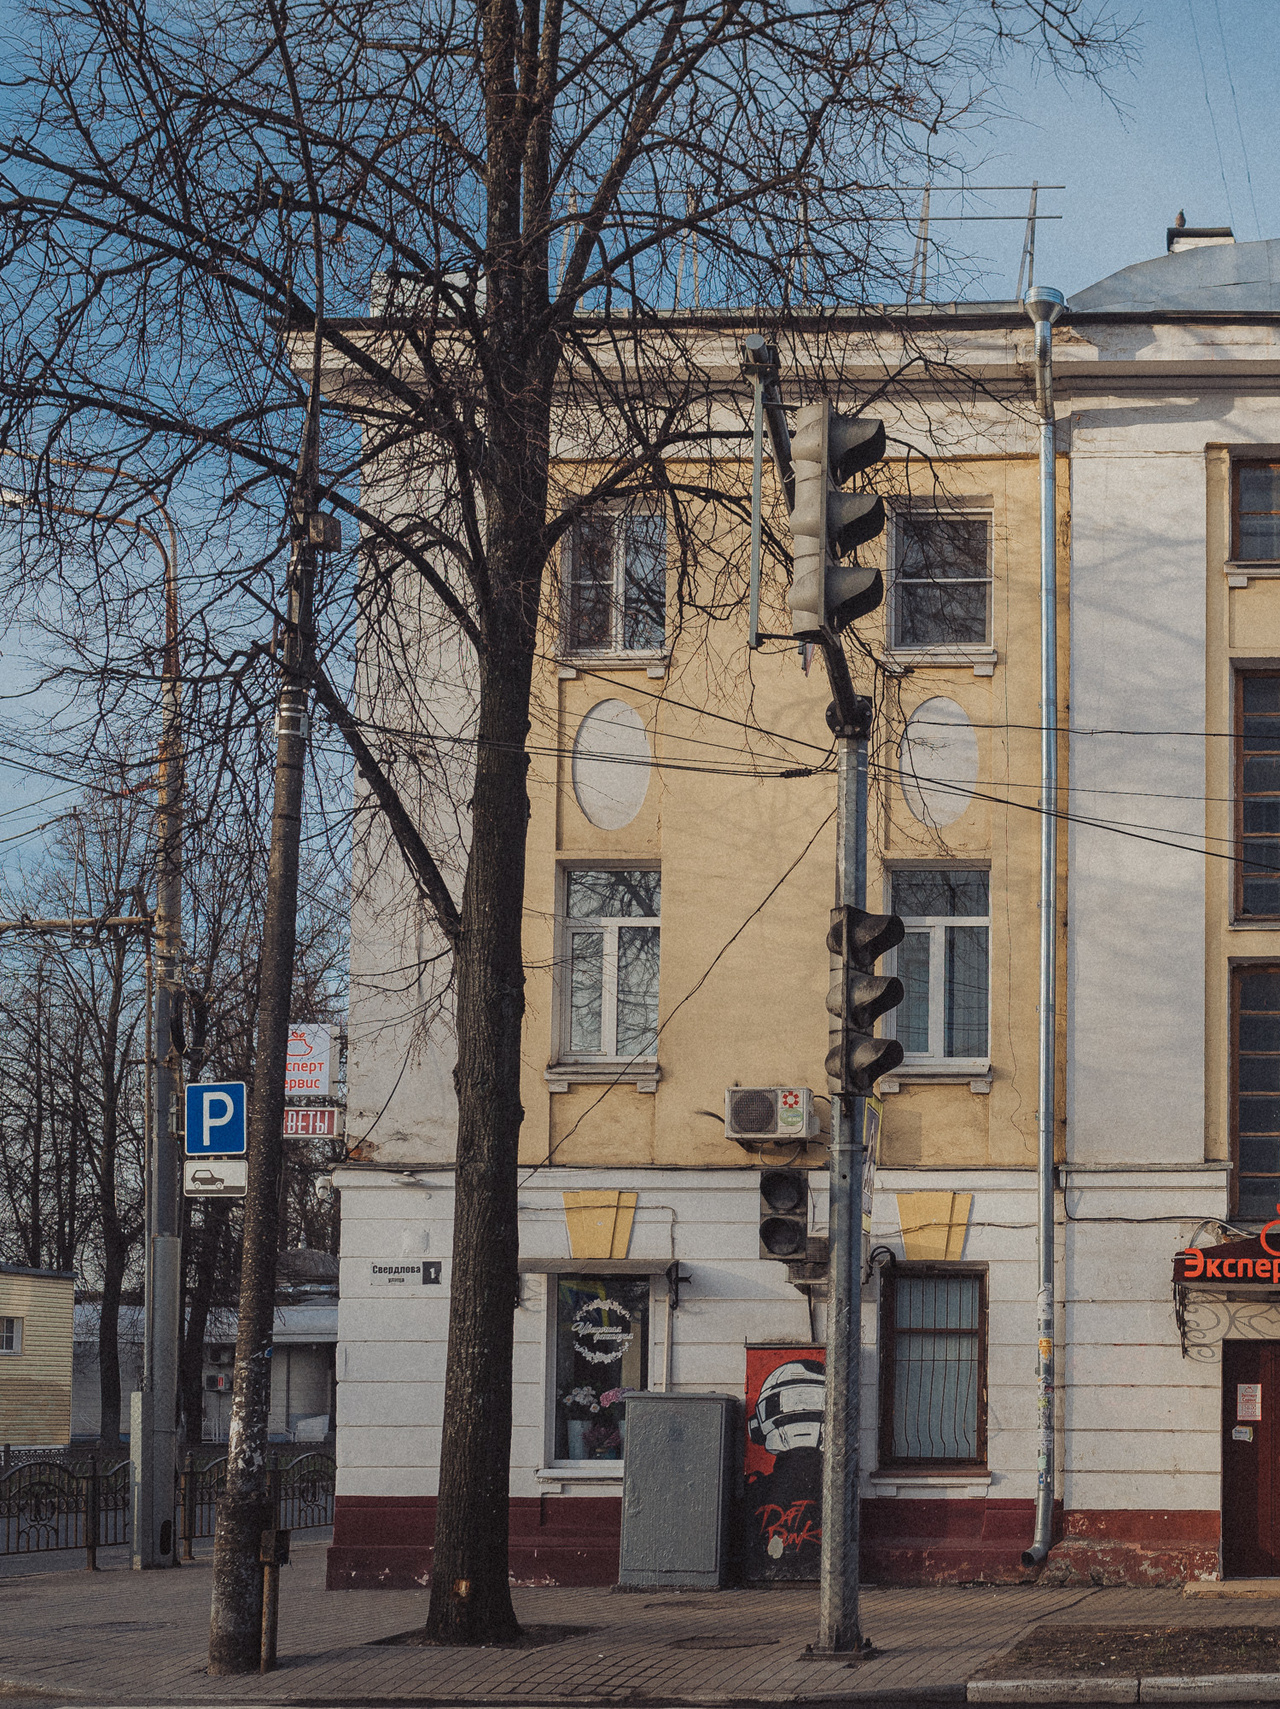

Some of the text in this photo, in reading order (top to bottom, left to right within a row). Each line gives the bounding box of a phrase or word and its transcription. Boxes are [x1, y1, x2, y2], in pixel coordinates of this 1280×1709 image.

[285, 1062, 324, 1074] сперт
[203, 1091, 234, 1146] P
[283, 1111, 328, 1134] ВЕТЫ
[372, 1265, 421, 1275] Свердлова
[429, 1267, 436, 1279] 1
